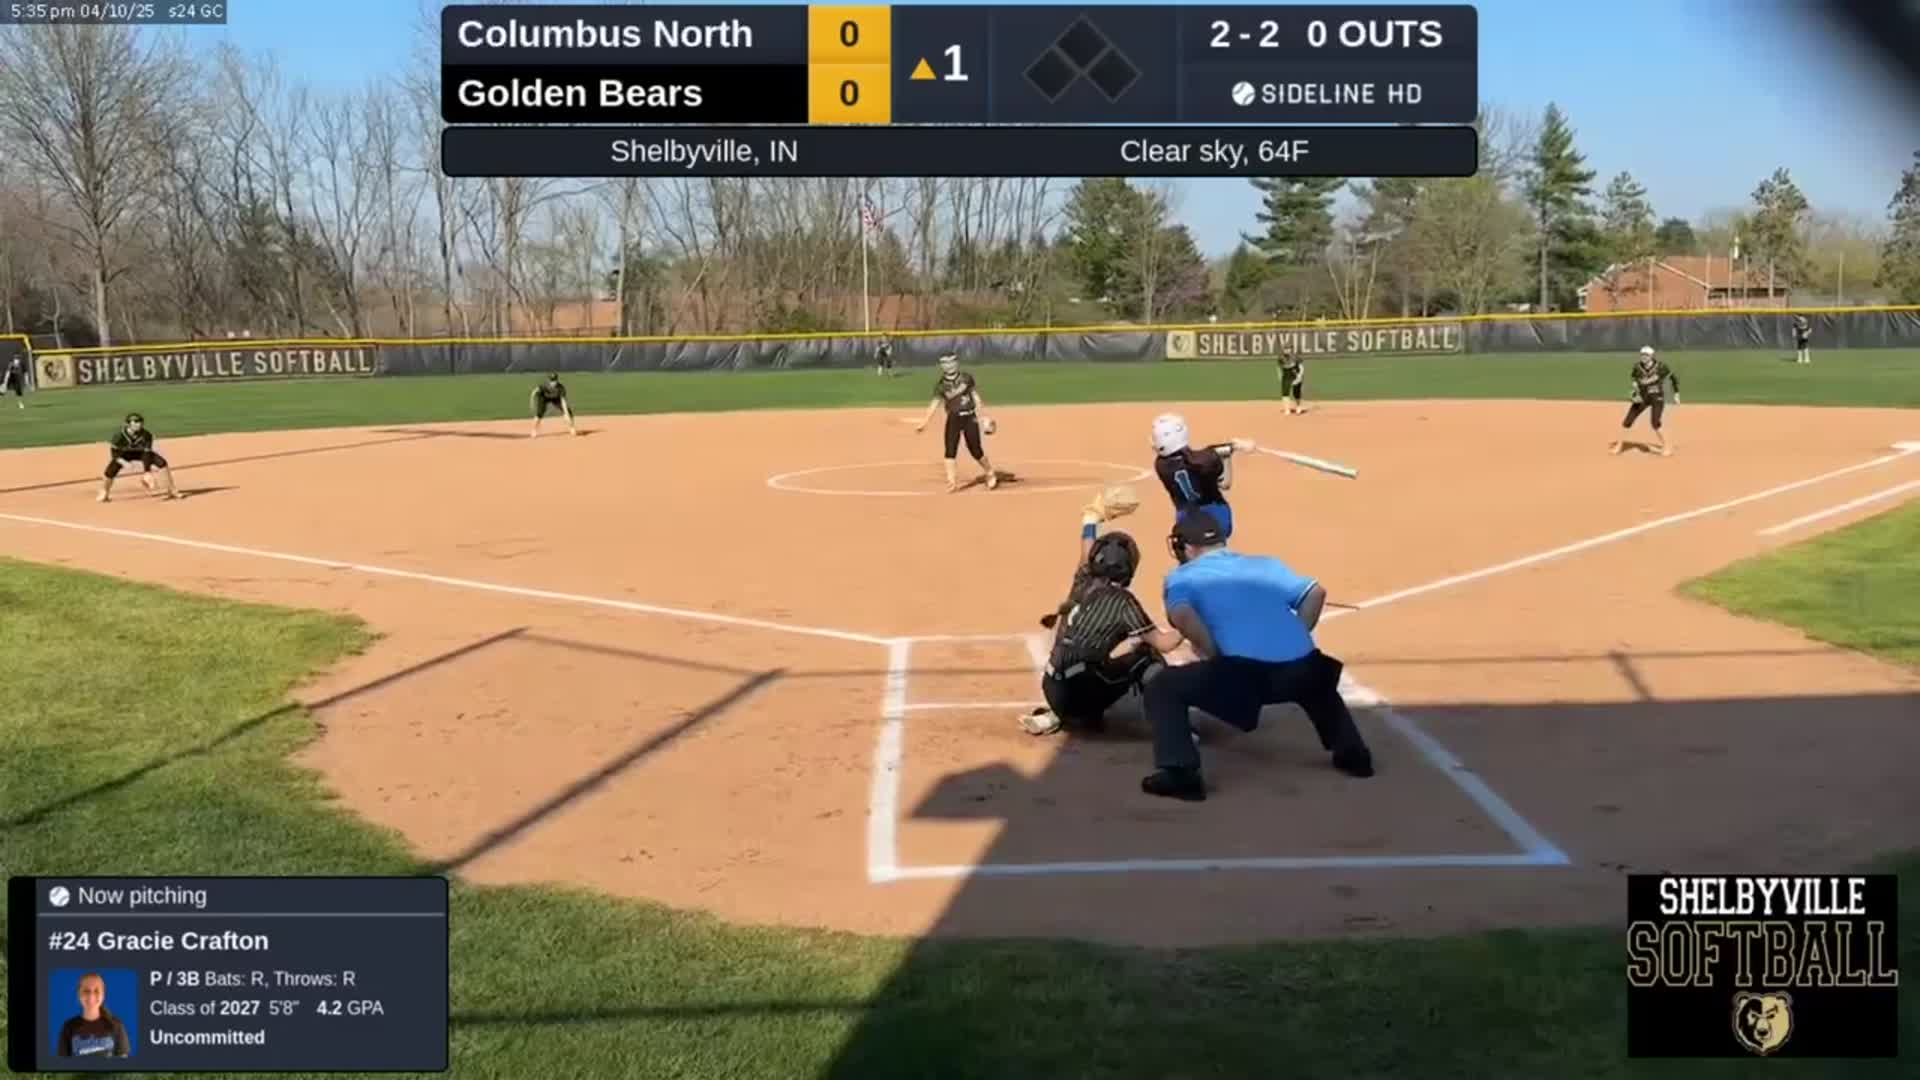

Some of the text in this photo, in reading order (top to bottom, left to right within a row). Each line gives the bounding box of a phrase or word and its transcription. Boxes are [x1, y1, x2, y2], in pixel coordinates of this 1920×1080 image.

[1199, 326, 1454, 355] SHELBYVILLE SOFTBALL
[79, 349, 371, 383] SHELBYVILLE SOFTBALL
[1174, 469, 1201, 501] 1
